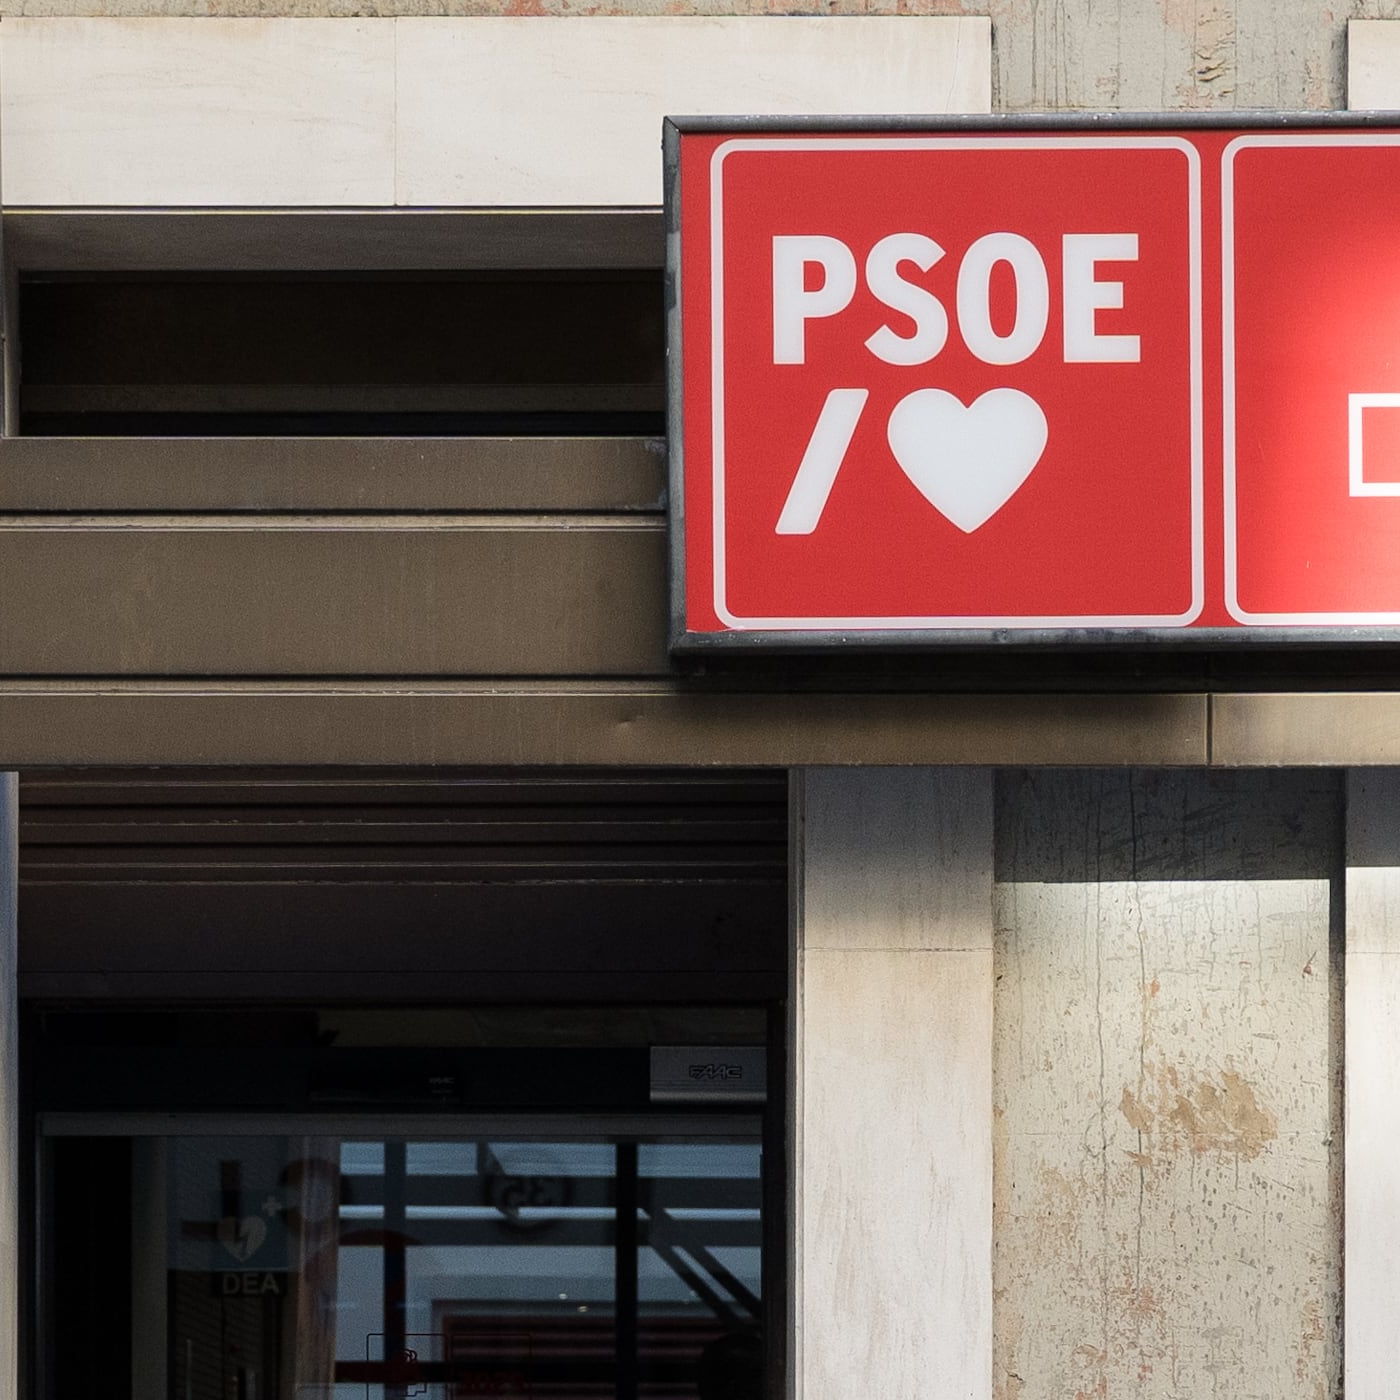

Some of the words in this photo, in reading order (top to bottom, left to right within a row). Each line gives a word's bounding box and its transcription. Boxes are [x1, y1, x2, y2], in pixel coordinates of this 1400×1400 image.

[771, 231, 1142, 366] PSOE
[688, 1063, 743, 1080] FAAC
[221, 1273, 281, 1295] DEA
